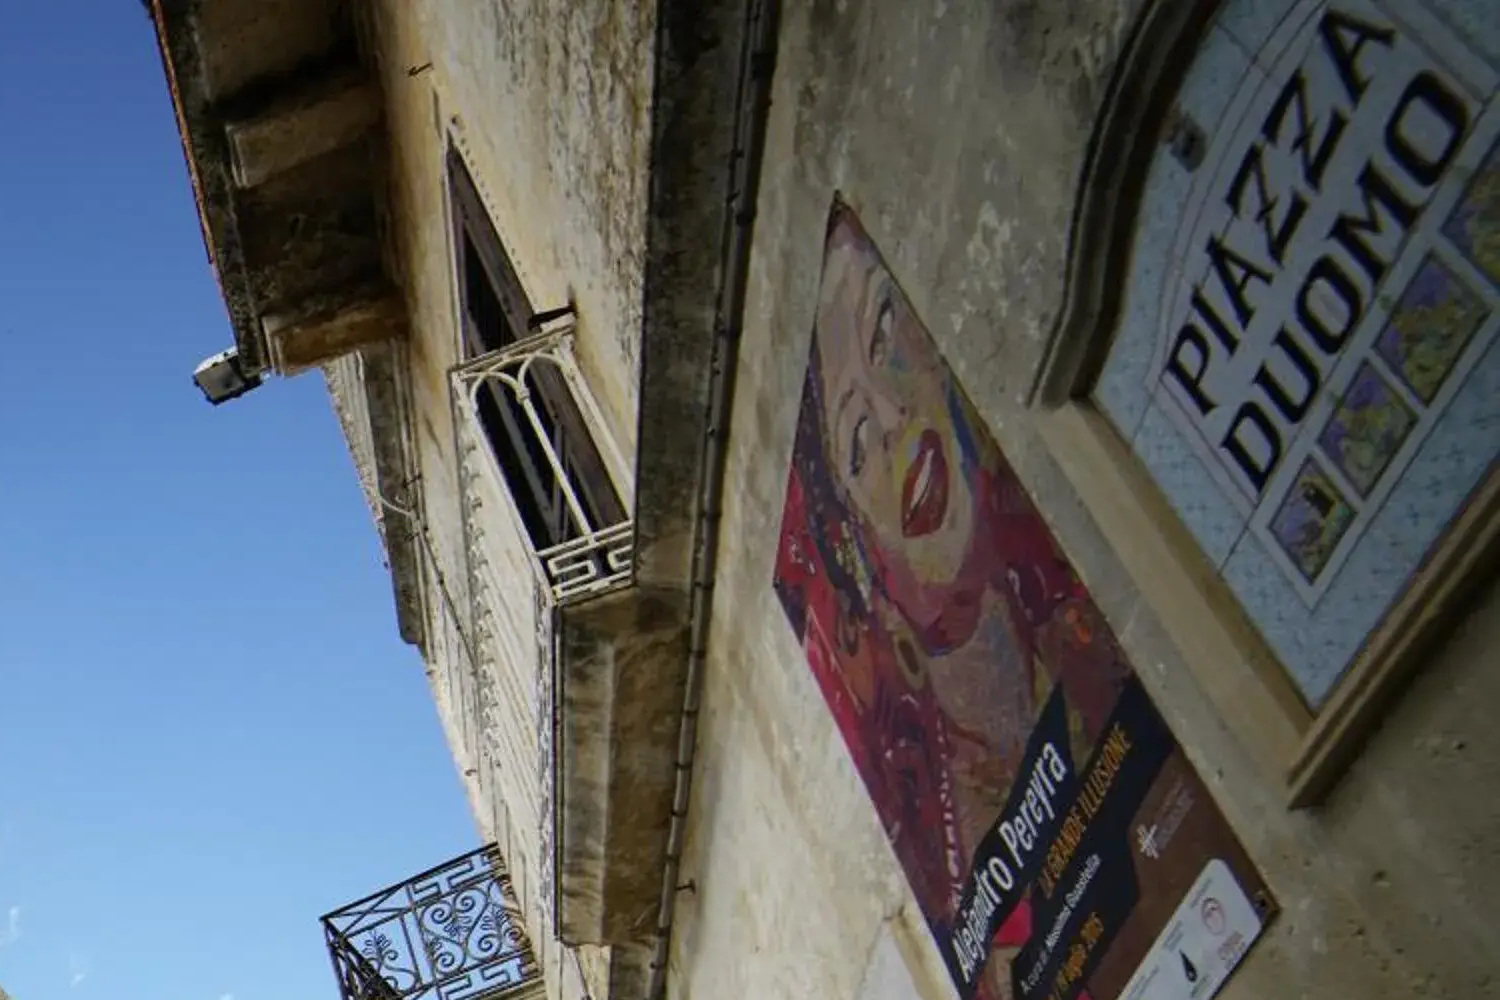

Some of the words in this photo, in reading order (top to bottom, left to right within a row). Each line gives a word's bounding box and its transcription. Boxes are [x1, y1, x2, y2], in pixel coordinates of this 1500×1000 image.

[1164, 6, 1397, 416] PIAZZA
[1219, 68, 1471, 495] DUOMO
[950, 857, 1014, 983] Alejandro
[998, 742, 1067, 868] Pereyra
[1045, 806, 1087, 879] GRANDE
[1076, 722, 1131, 821] ILLUSIONE
